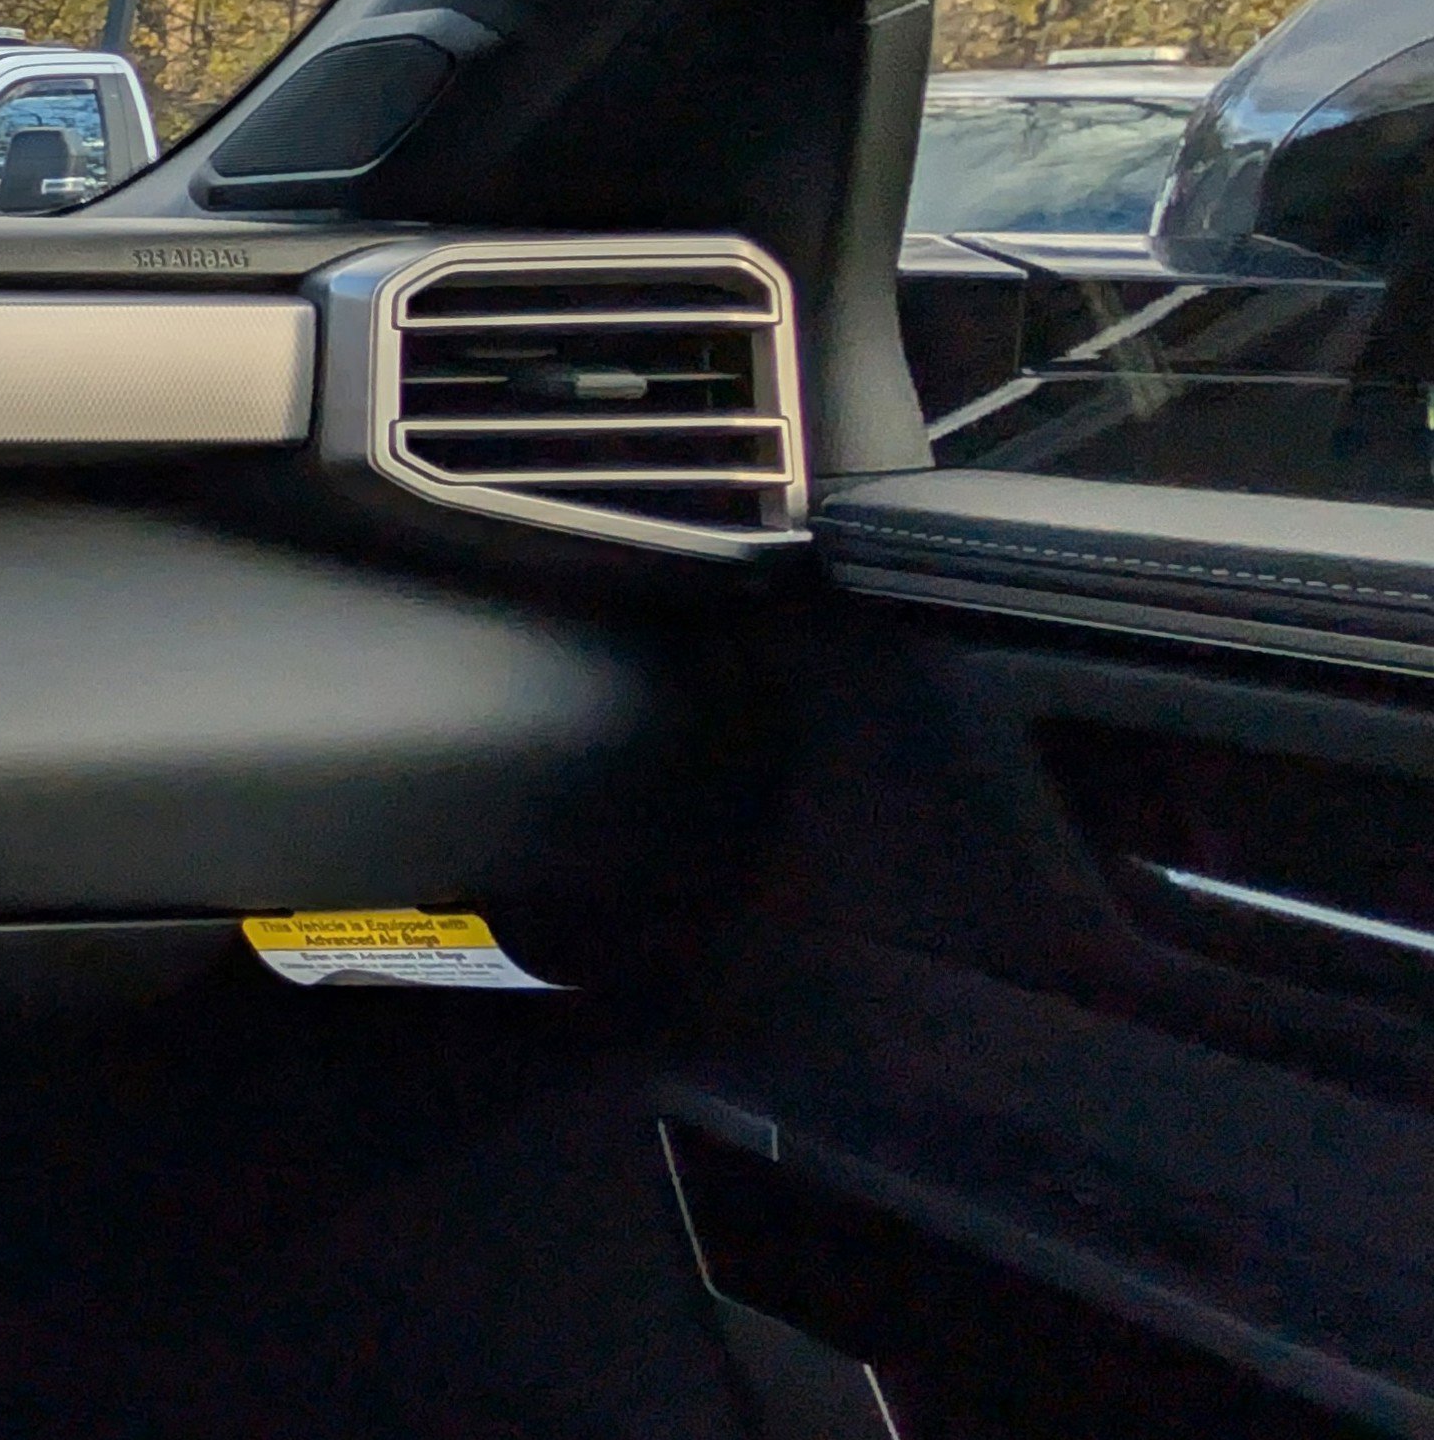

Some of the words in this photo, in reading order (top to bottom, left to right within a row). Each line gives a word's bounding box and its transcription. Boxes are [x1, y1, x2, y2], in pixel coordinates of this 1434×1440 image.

[132, 249, 166, 268] SRS
[170, 249, 249, 268] AIRBAG
[259, 921, 292, 933] This
[293, 919, 346, 932] Vehicle
[348, 919, 364, 931] is
[365, 918, 434, 933] Equipped
[436, 918, 468, 930] with
[305, 934, 376, 946] Advanced
[379, 934, 399, 945] Air
[402, 932, 441, 947] Bags
